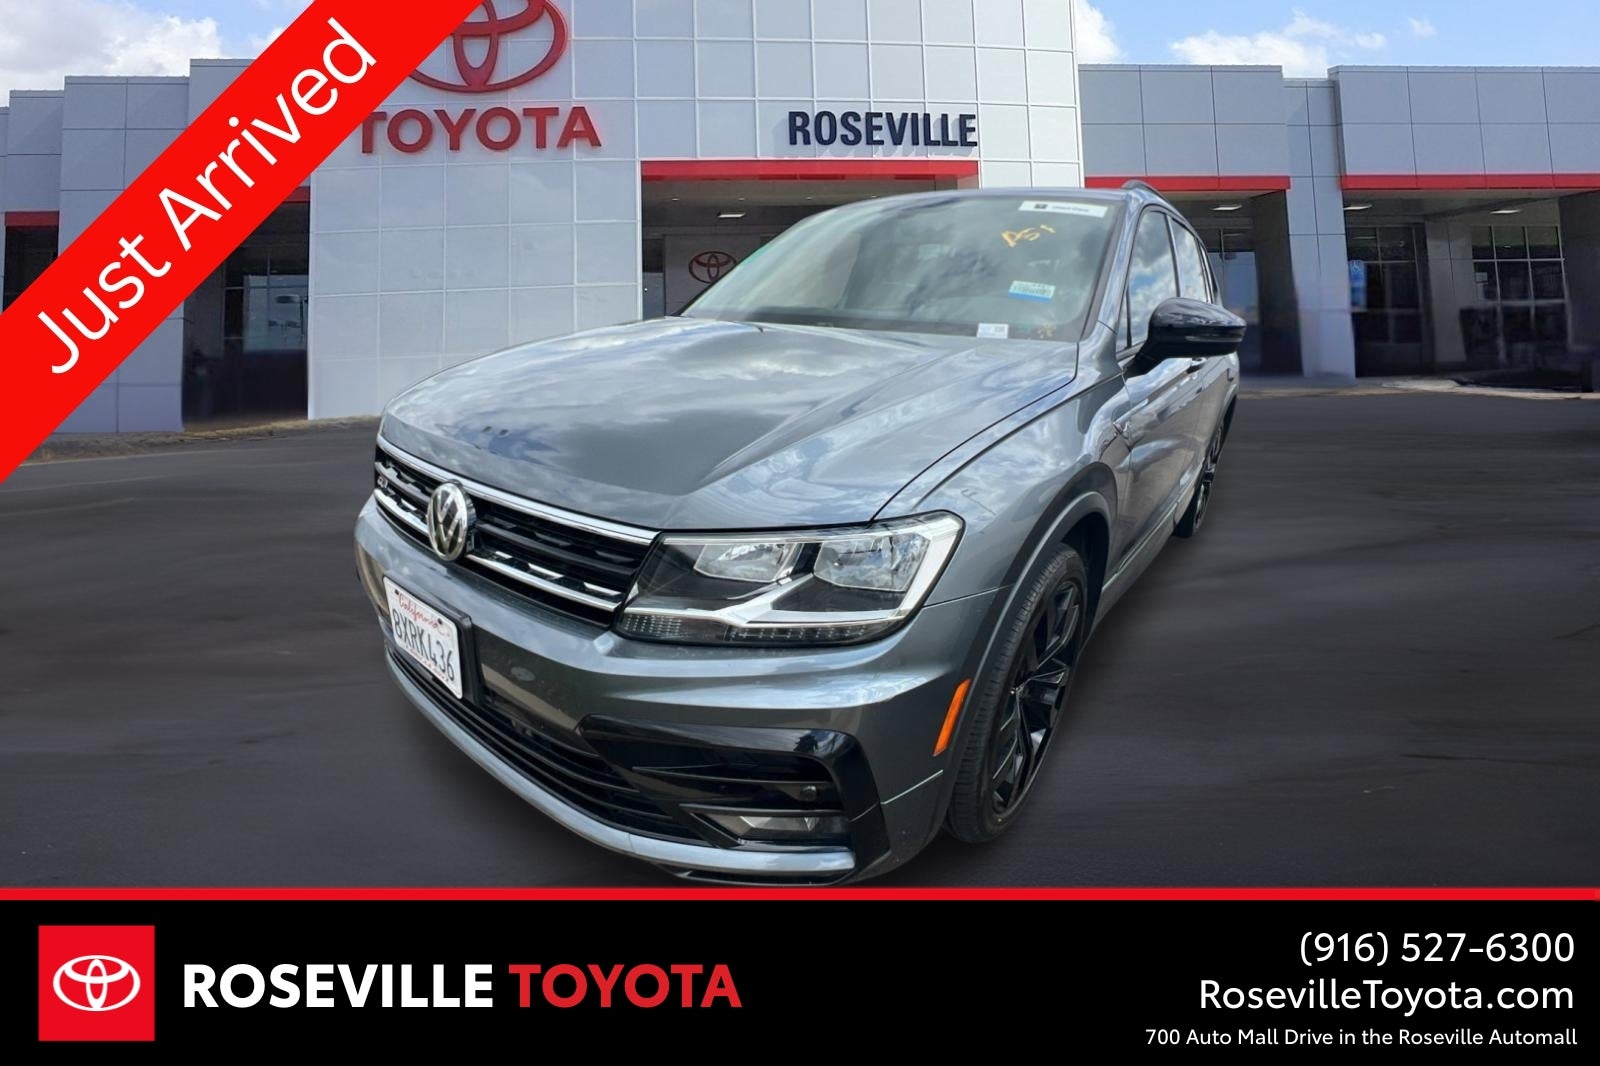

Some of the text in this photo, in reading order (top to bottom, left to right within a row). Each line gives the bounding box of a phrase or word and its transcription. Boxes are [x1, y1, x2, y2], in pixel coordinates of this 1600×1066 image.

[361, 106, 602, 154] TOYOTA
[788, 111, 978, 146] ROSEVILLE
[392, 608, 455, 681] 8XRK436
